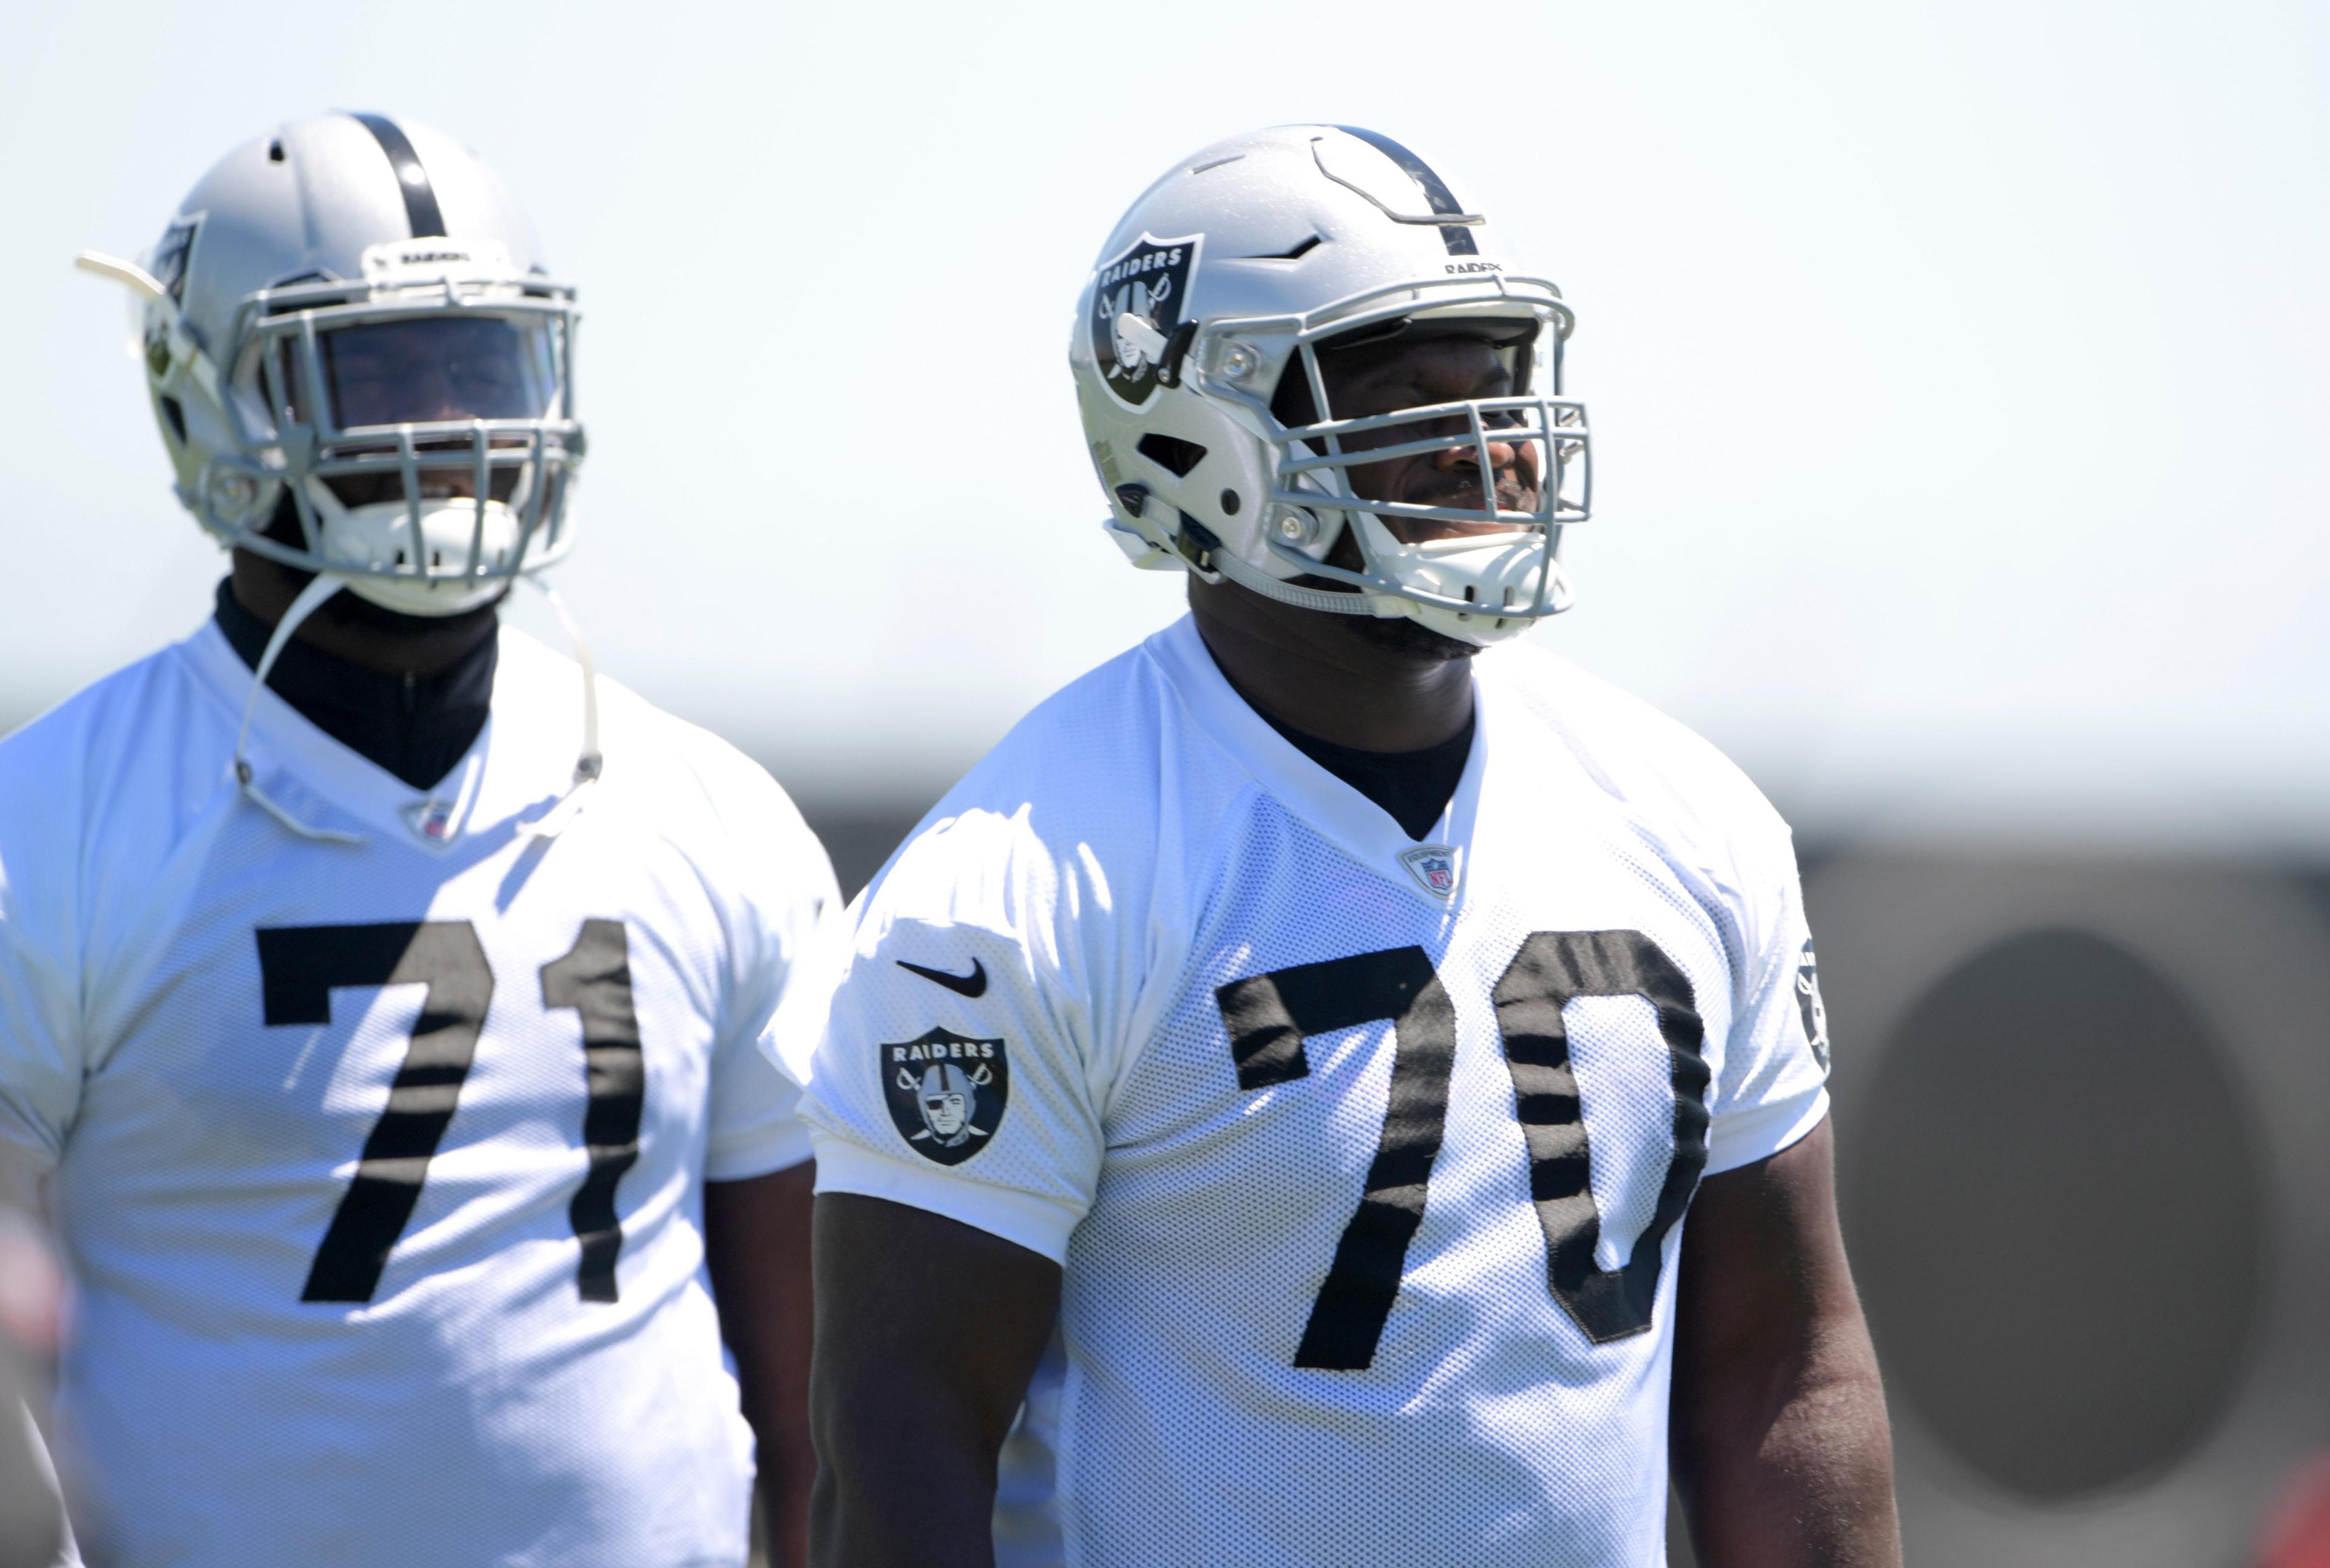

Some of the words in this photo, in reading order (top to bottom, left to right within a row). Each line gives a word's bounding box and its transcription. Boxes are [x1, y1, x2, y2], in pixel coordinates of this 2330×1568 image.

[1101, 248, 1183, 288] RAIDERS
[254, 917, 646, 1304] 71
[893, 1043, 995, 1062] RAIDERS
[1215, 929, 1712, 1372] 70
